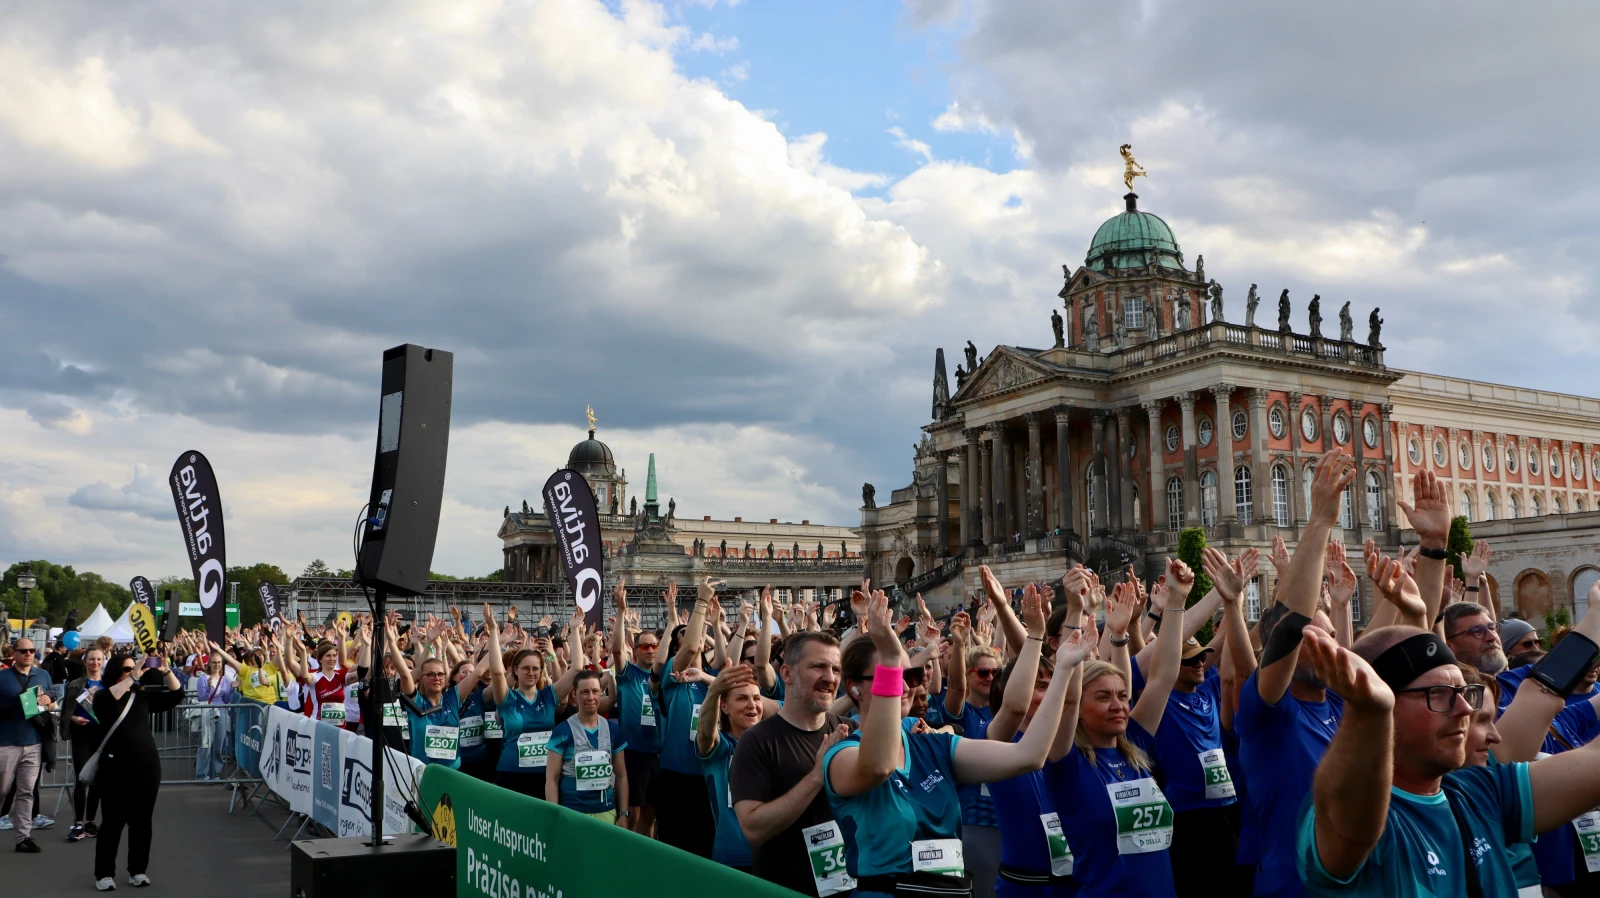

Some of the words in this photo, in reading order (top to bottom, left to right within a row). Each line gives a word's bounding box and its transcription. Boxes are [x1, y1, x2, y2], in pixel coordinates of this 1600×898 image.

[460, 726, 480, 738] 2677
[429, 738, 455, 749] 2507
[524, 744, 548, 756] 2659
[580, 764, 613, 778] 2560
[1132, 805, 1164, 829] 257
[468, 808, 492, 839] Unser
[493, 819, 546, 862] Anspruch:
[467, 847, 520, 898] Präzise
